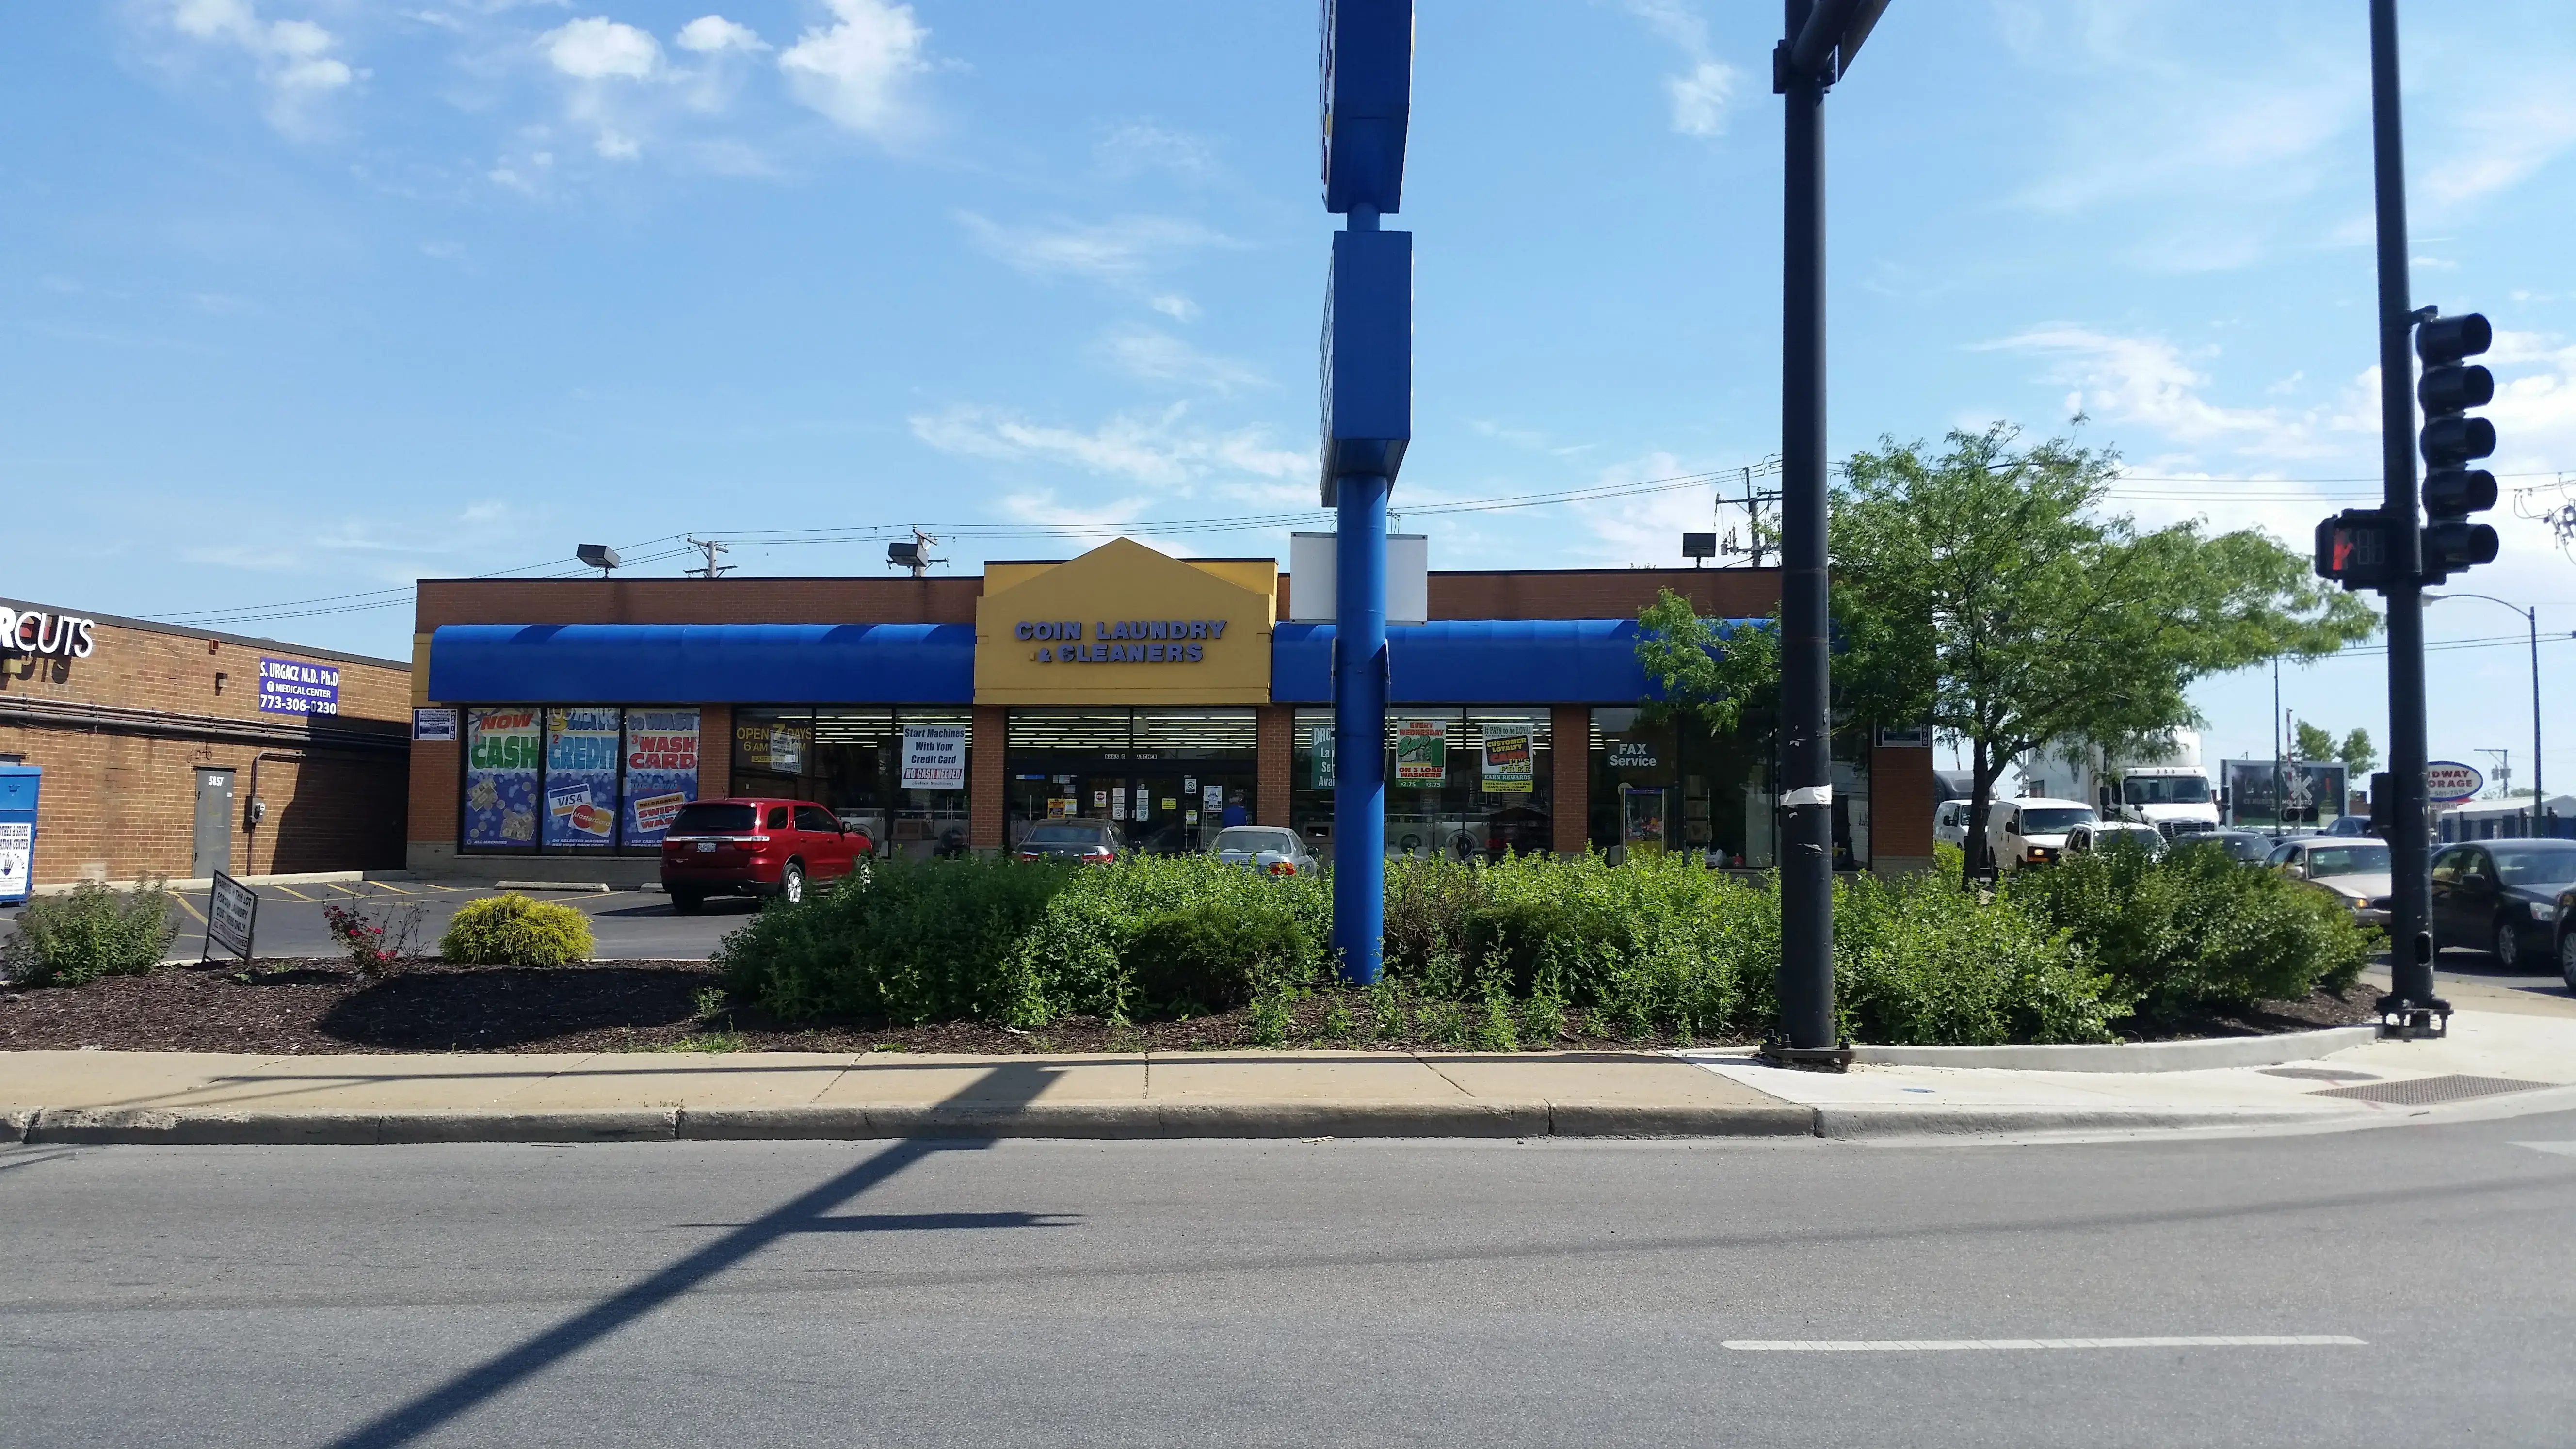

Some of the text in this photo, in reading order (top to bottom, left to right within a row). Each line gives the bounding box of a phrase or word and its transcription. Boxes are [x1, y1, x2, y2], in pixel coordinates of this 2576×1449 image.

[0, 606, 95, 658] RCUTS
[1014, 620, 1227, 640] COIN LAUNDRY
[1037, 644, 1203, 662] & CLEANERS
[260, 661, 338, 686] S. URGACZ M.D. Ph.D
[275, 683, 331, 698] MEDICAL CENTER
[260, 694, 337, 715] 773-306-0230
[480, 713, 533, 730] NOW
[548, 708, 568, 731] 3
[645, 713, 699, 731] WASH
[736, 723, 812, 740] OPEN 7 DAYS
[905, 728, 964, 737] Start Machines
[474, 734, 479, 744] 1
[553, 734, 559, 744] 2
[631, 734, 638, 744] 3
[640, 736, 697, 752] WASH
[1487, 738, 1527, 747] CUSTOMER
[744, 741, 751, 751] 6
[916, 742, 953, 751] With Your
[1492, 744, 1522, 753] LOYALTY
[1619, 743, 1647, 755] FAX
[471, 736, 538, 770] CASH
[548, 737, 619, 770] CREDIT
[1490, 751, 1528, 763] CARD
[629, 753, 697, 769] CARD
[911, 755, 956, 764] Credit Card
[1610, 755, 1657, 766] Service
[906, 769, 960, 779] NO CASH NEEDED
[209, 776, 224, 786] 5857
[557, 794, 583, 806] VISA
[639, 797, 680, 807] RELOADABLE
[573, 812, 610, 826] MasterCard
[640, 817, 674, 829] WAS
[16, 826, 28, 837] SHOES
[13, 839, 28, 850] CENTER
[243, 895, 252, 907] LOT
[234, 920, 245, 933] ONLY
